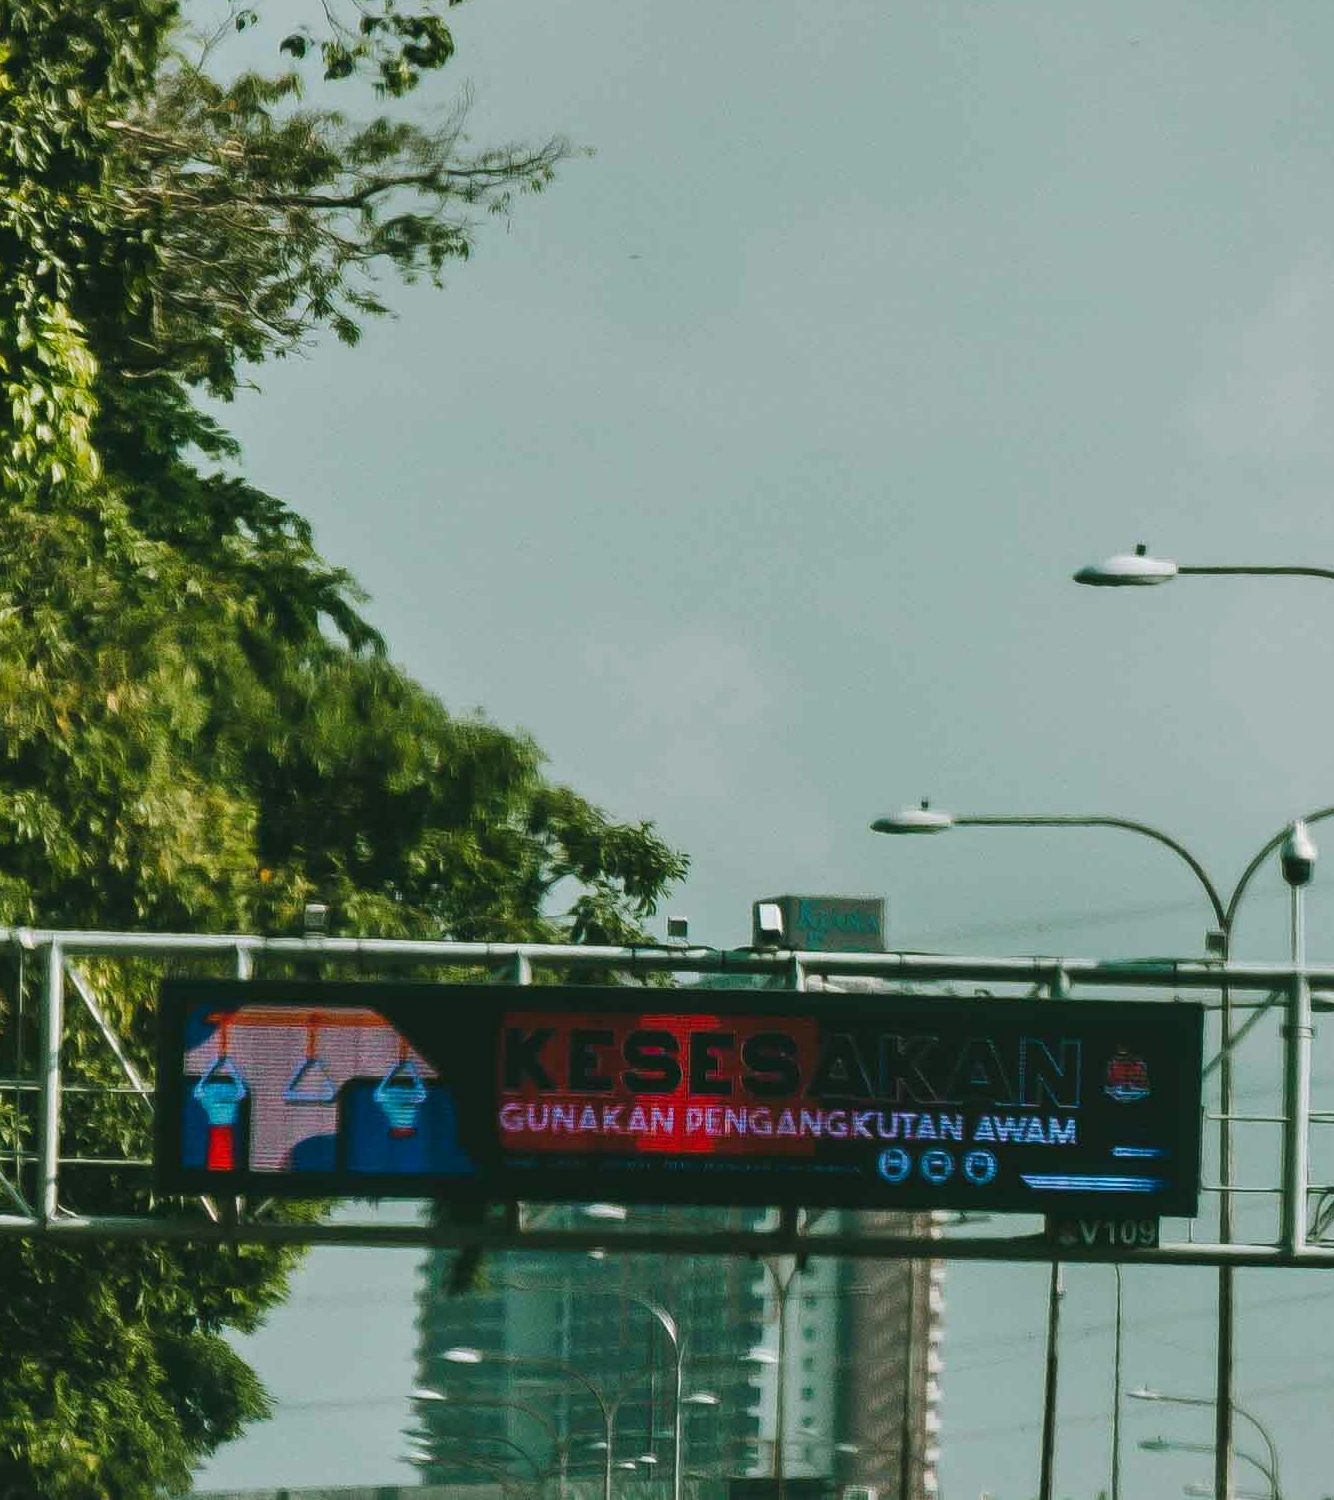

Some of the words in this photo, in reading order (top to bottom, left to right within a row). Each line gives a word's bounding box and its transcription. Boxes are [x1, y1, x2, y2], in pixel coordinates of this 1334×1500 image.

[503, 1026, 1082, 1109] KESESAKAN
[499, 1102, 675, 1135] GUNAKAN
[685, 1106, 964, 1143] PENGANGKUTAN
[972, 1114, 1078, 1145] AWAM
